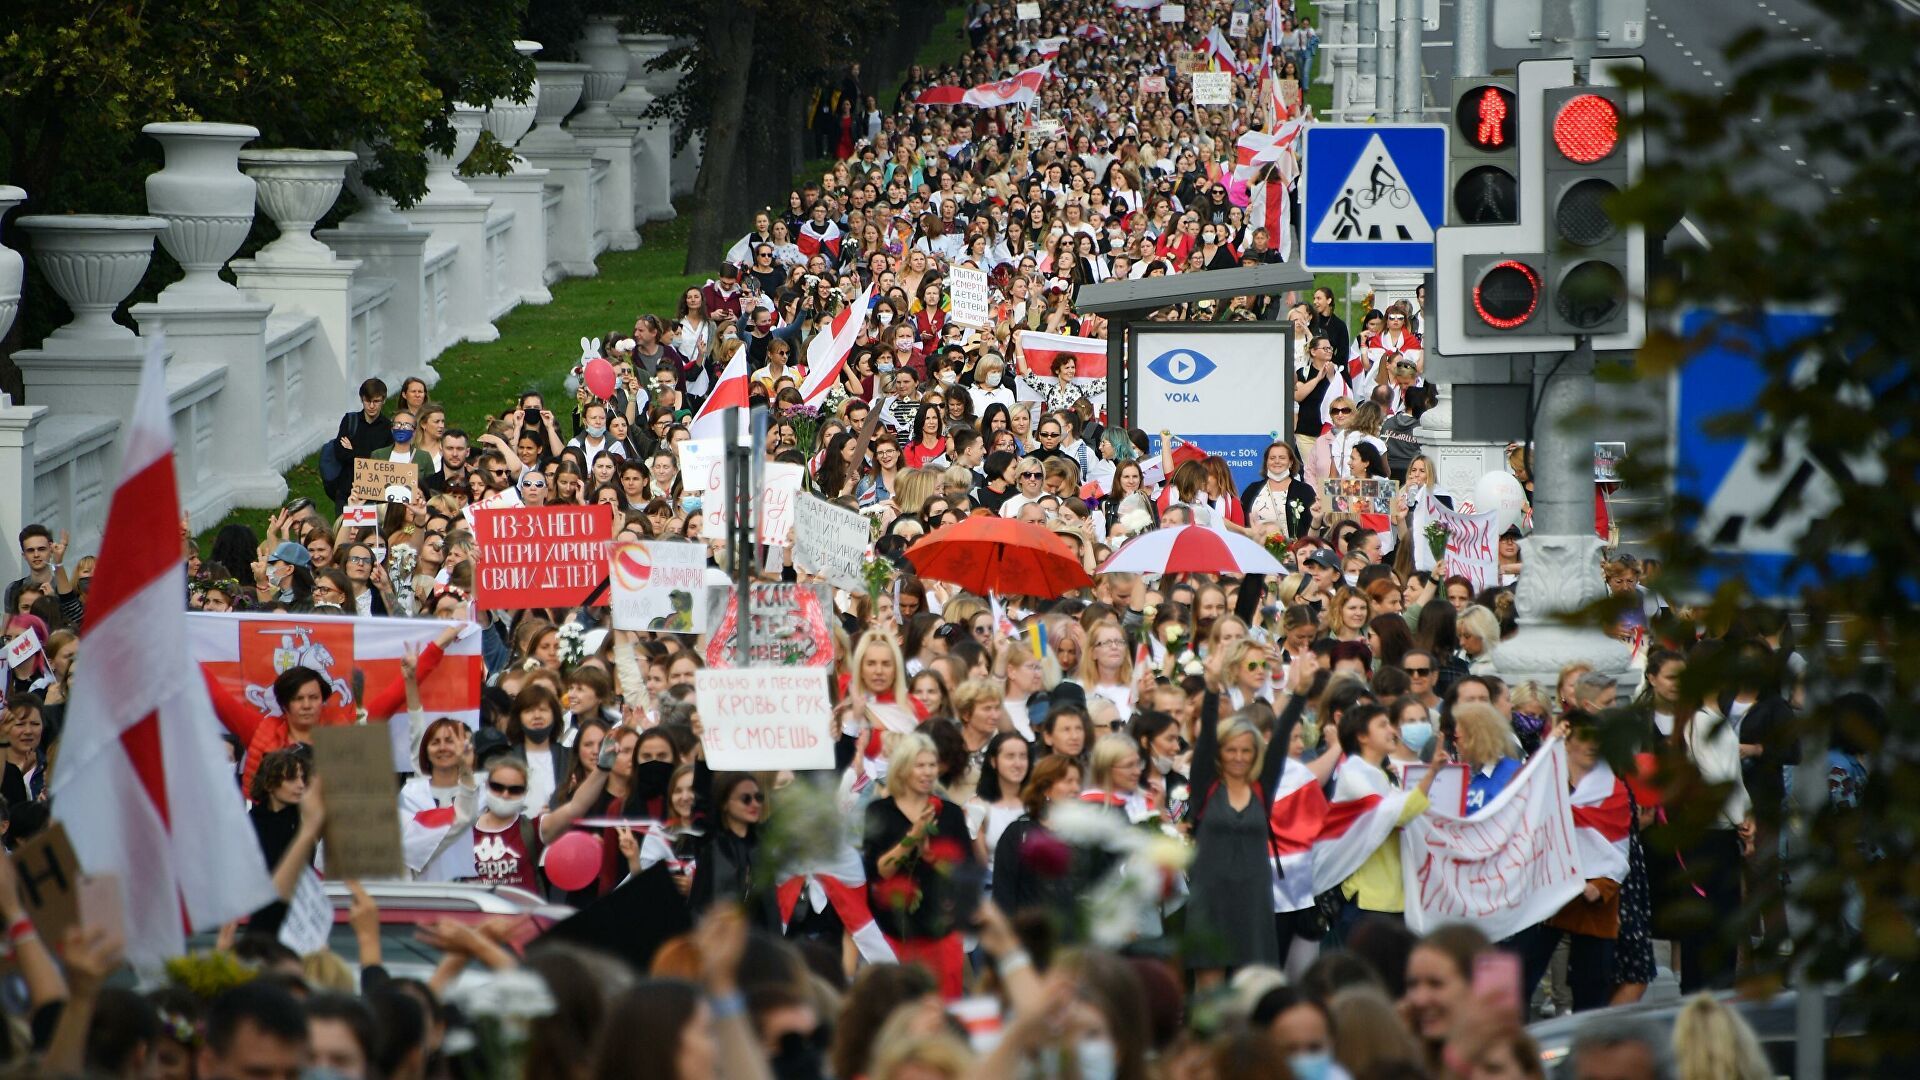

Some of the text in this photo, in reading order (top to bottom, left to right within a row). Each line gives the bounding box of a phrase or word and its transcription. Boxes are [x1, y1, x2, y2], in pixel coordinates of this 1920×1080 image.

[1164, 393, 1200, 403] VOKA
[1238, 449, 1258, 457] 50%
[357, 461, 395, 472] ЗА СЕБЯ
[356, 472, 406, 485] И ЗА ТОГО
[493, 512, 595, 539] ИЗ-ЗА НЕГО
[481, 562, 597, 590] СВОИХ ДЕТЕЙ
[770, 677, 823, 690] ПЕСКОМ
[717, 695, 826, 717] КРОВЬ С РУК
[733, 726, 819, 750] СМОЕШЬ
[477, 860, 518, 879] appa
